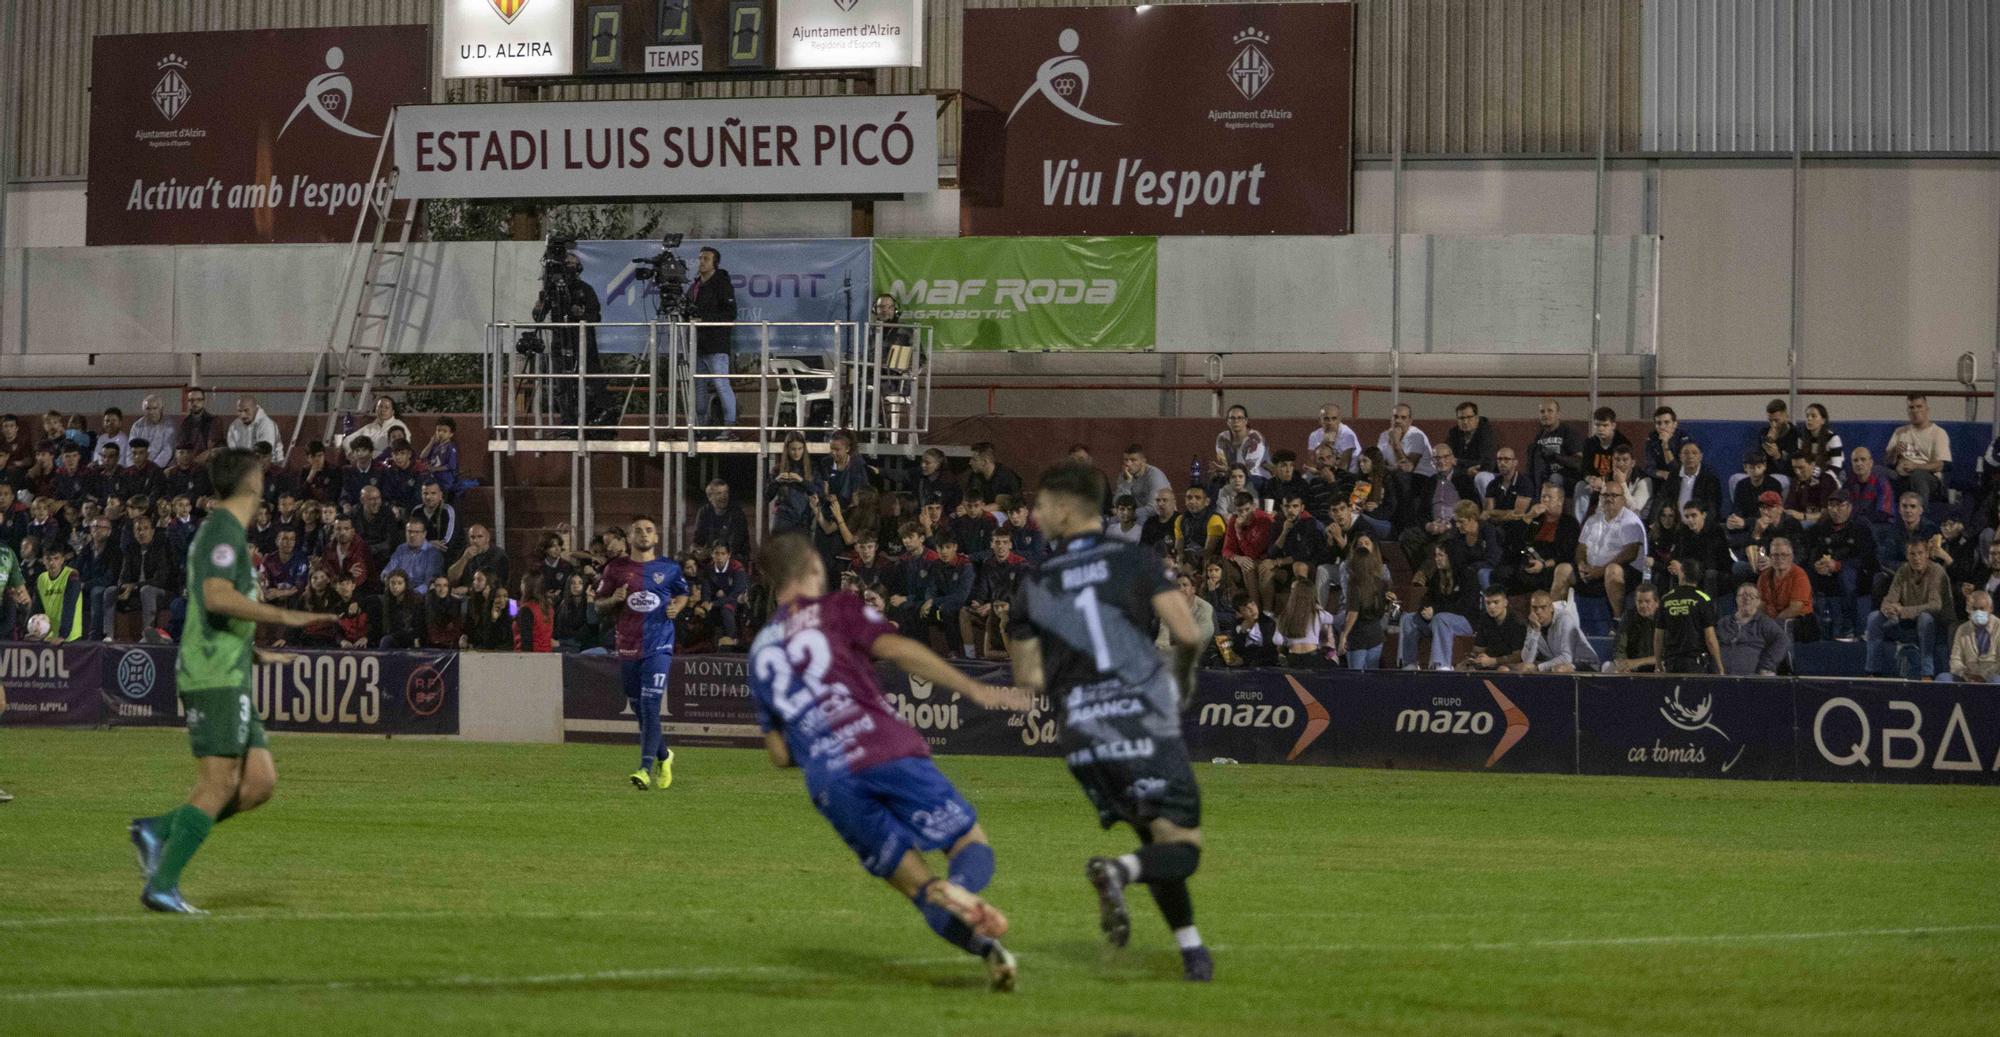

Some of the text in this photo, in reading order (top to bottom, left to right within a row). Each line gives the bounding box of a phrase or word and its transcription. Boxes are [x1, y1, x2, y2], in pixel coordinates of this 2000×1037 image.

[591, 11, 619, 64] 0
[732, 7, 762, 60] 0
[792, 24, 901, 39] Ajuntament d'Alzira
[460, 41, 553, 59] U.D. ALZIRA
[648, 50, 699, 68] TEMPS
[1207, 108, 1293, 122] Ajuntament d'Alzira
[135, 127, 207, 140] Ajuntament d'Alzira
[416, 111, 914, 172] ESTADI LUIS SUÑER PICÓ
[126, 176, 223, 211] Activa't
[227, 175, 283, 209] amb
[1042, 158, 1266, 218] Viu l'esport
[1074, 585, 1112, 673] 1
[653, 673, 667, 687] 17
[754, 628, 832, 720] 22
[684, 682, 751, 698] MEDIAD
[1234, 690, 1263, 701] GRUPO
[1432, 696, 1462, 707] GRUPO
[1022, 708, 1059, 746] Sa
[1199, 703, 1295, 729] mazo
[1395, 708, 1494, 735] mazo
[1627, 738, 1706, 763] ca tomàs
